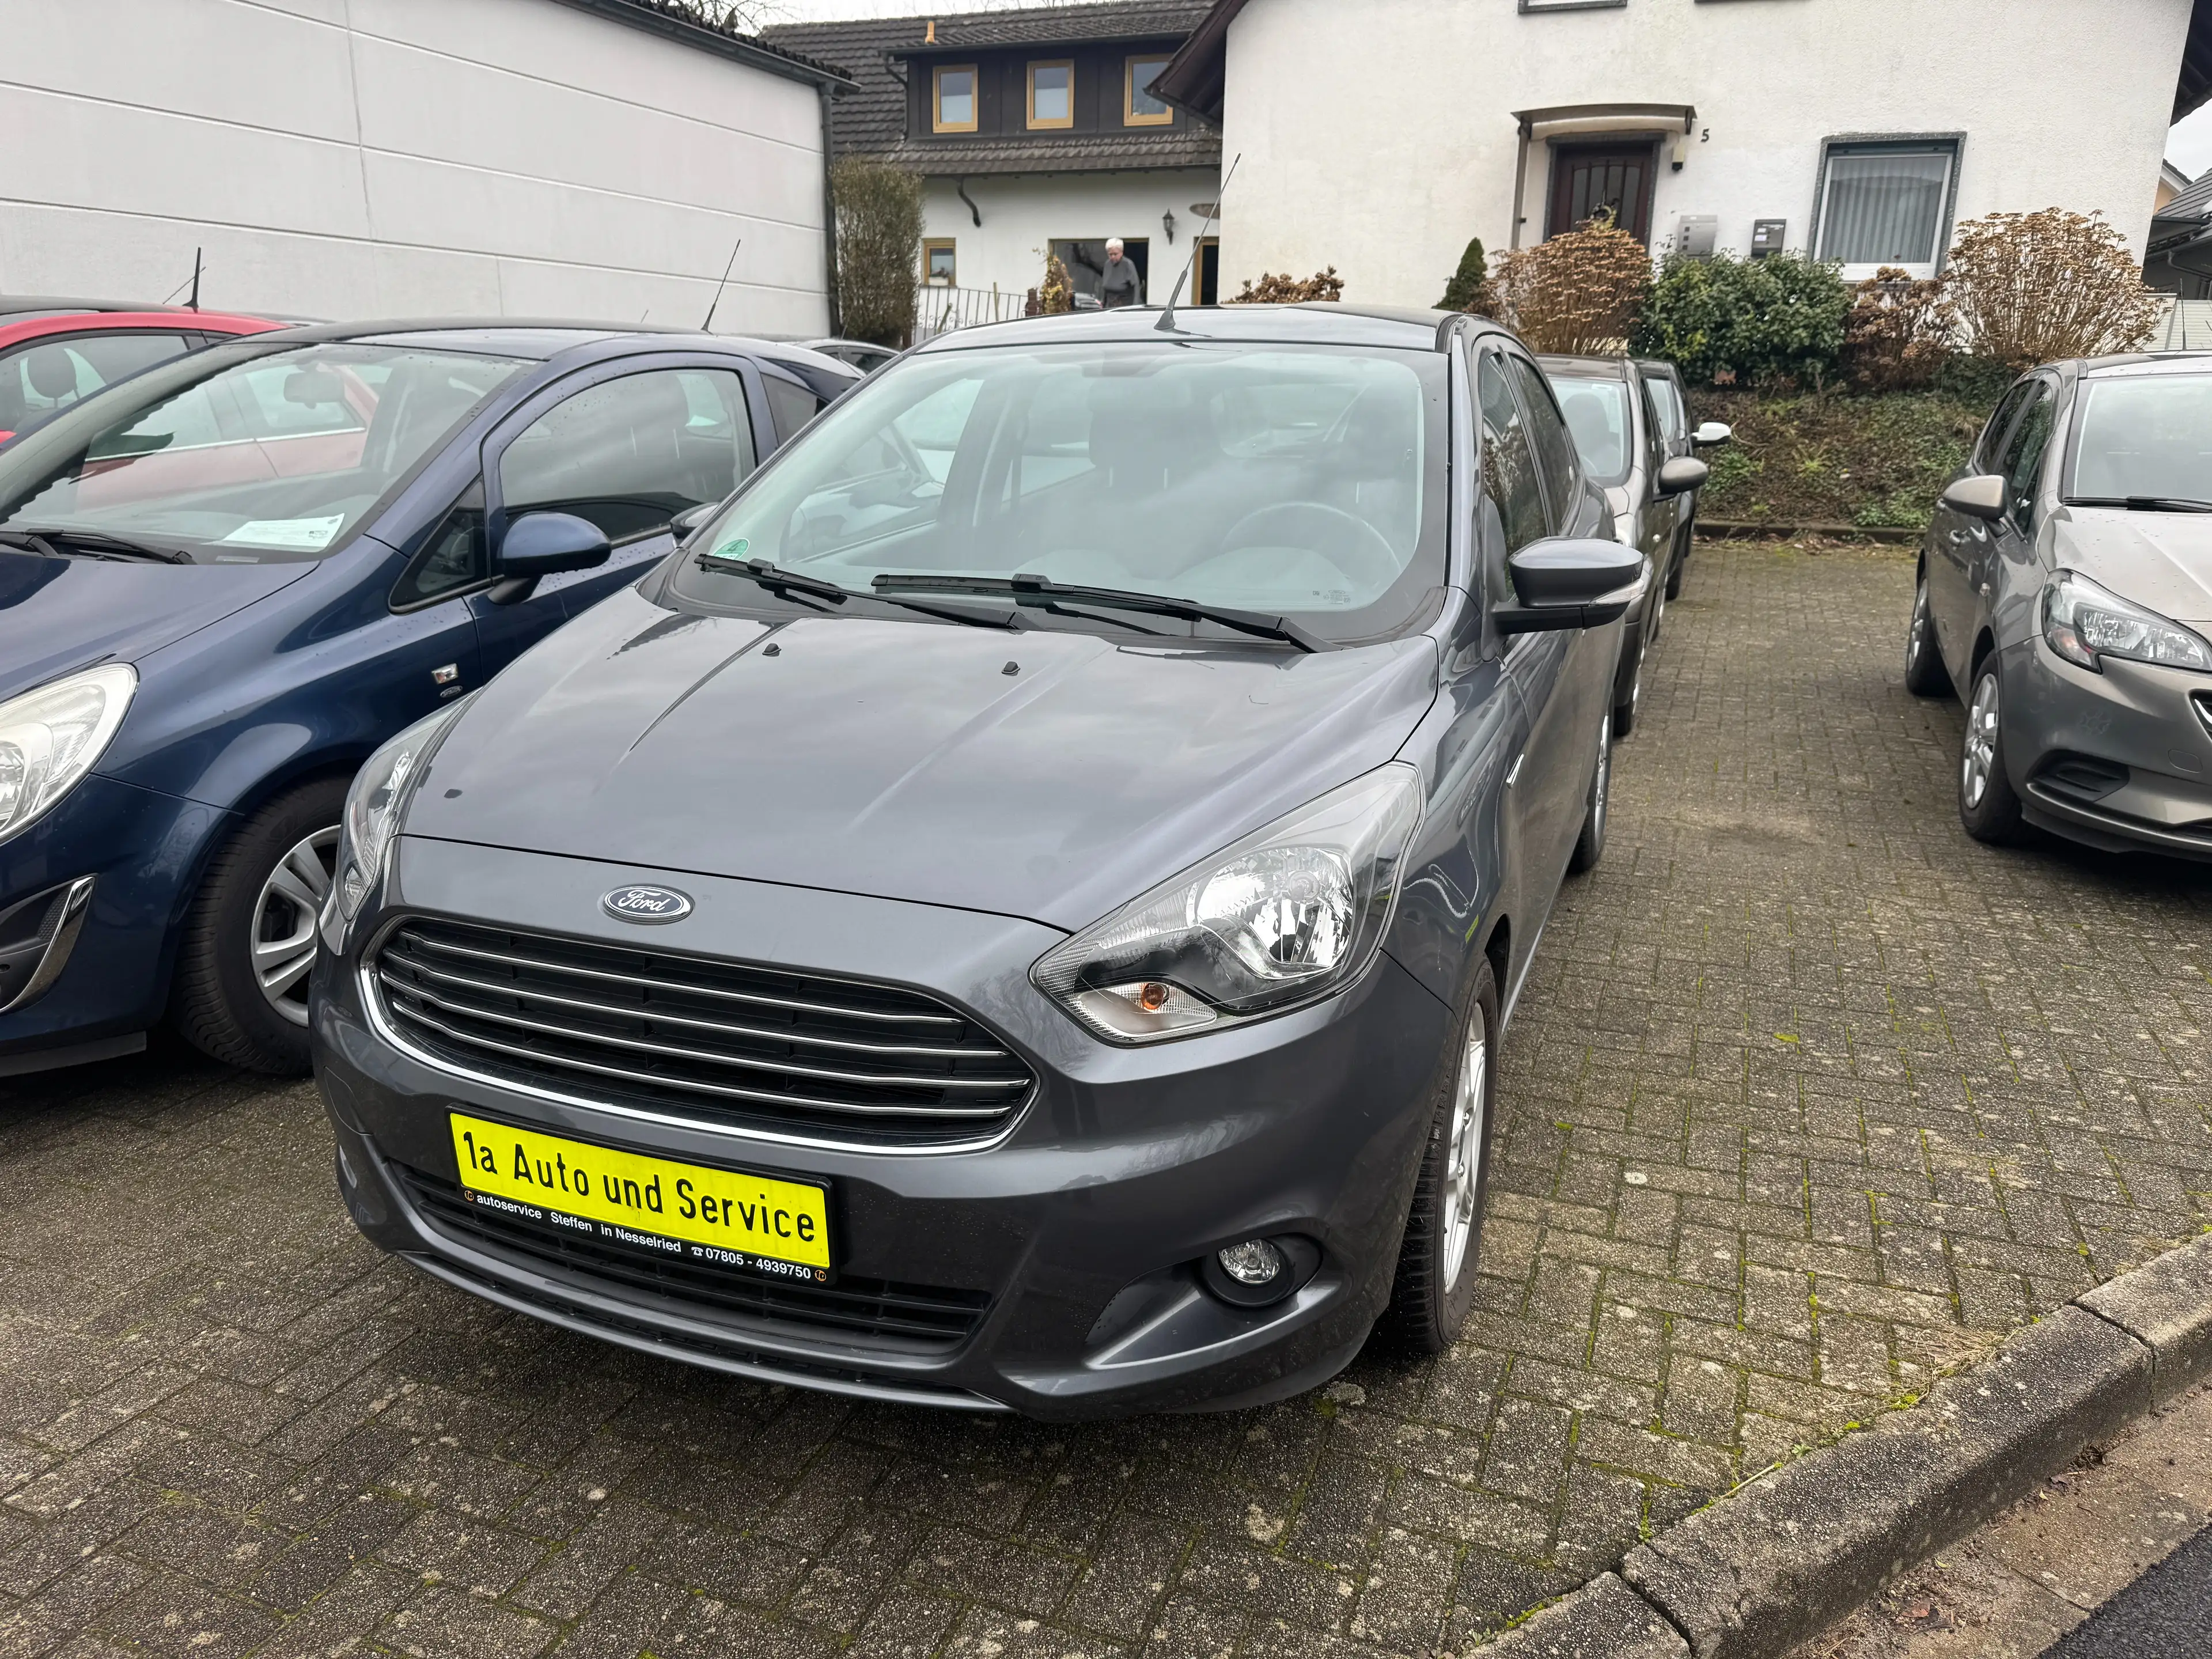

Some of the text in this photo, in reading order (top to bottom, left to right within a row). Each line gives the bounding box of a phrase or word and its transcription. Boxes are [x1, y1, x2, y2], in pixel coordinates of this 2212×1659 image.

[1700, 128, 1710, 142] 5
[618, 889, 671, 912] Ford
[463, 1131, 815, 1242] 1a Auto und Service
[476, 1194, 542, 1219] autoservice
[550, 1211, 592, 1232] Steffen
[600, 1224, 612, 1237] in
[615, 1227, 681, 1252] Nesselried
[705, 1247, 744, 1266] 07805
[756, 1258, 811, 1279] 4939750
